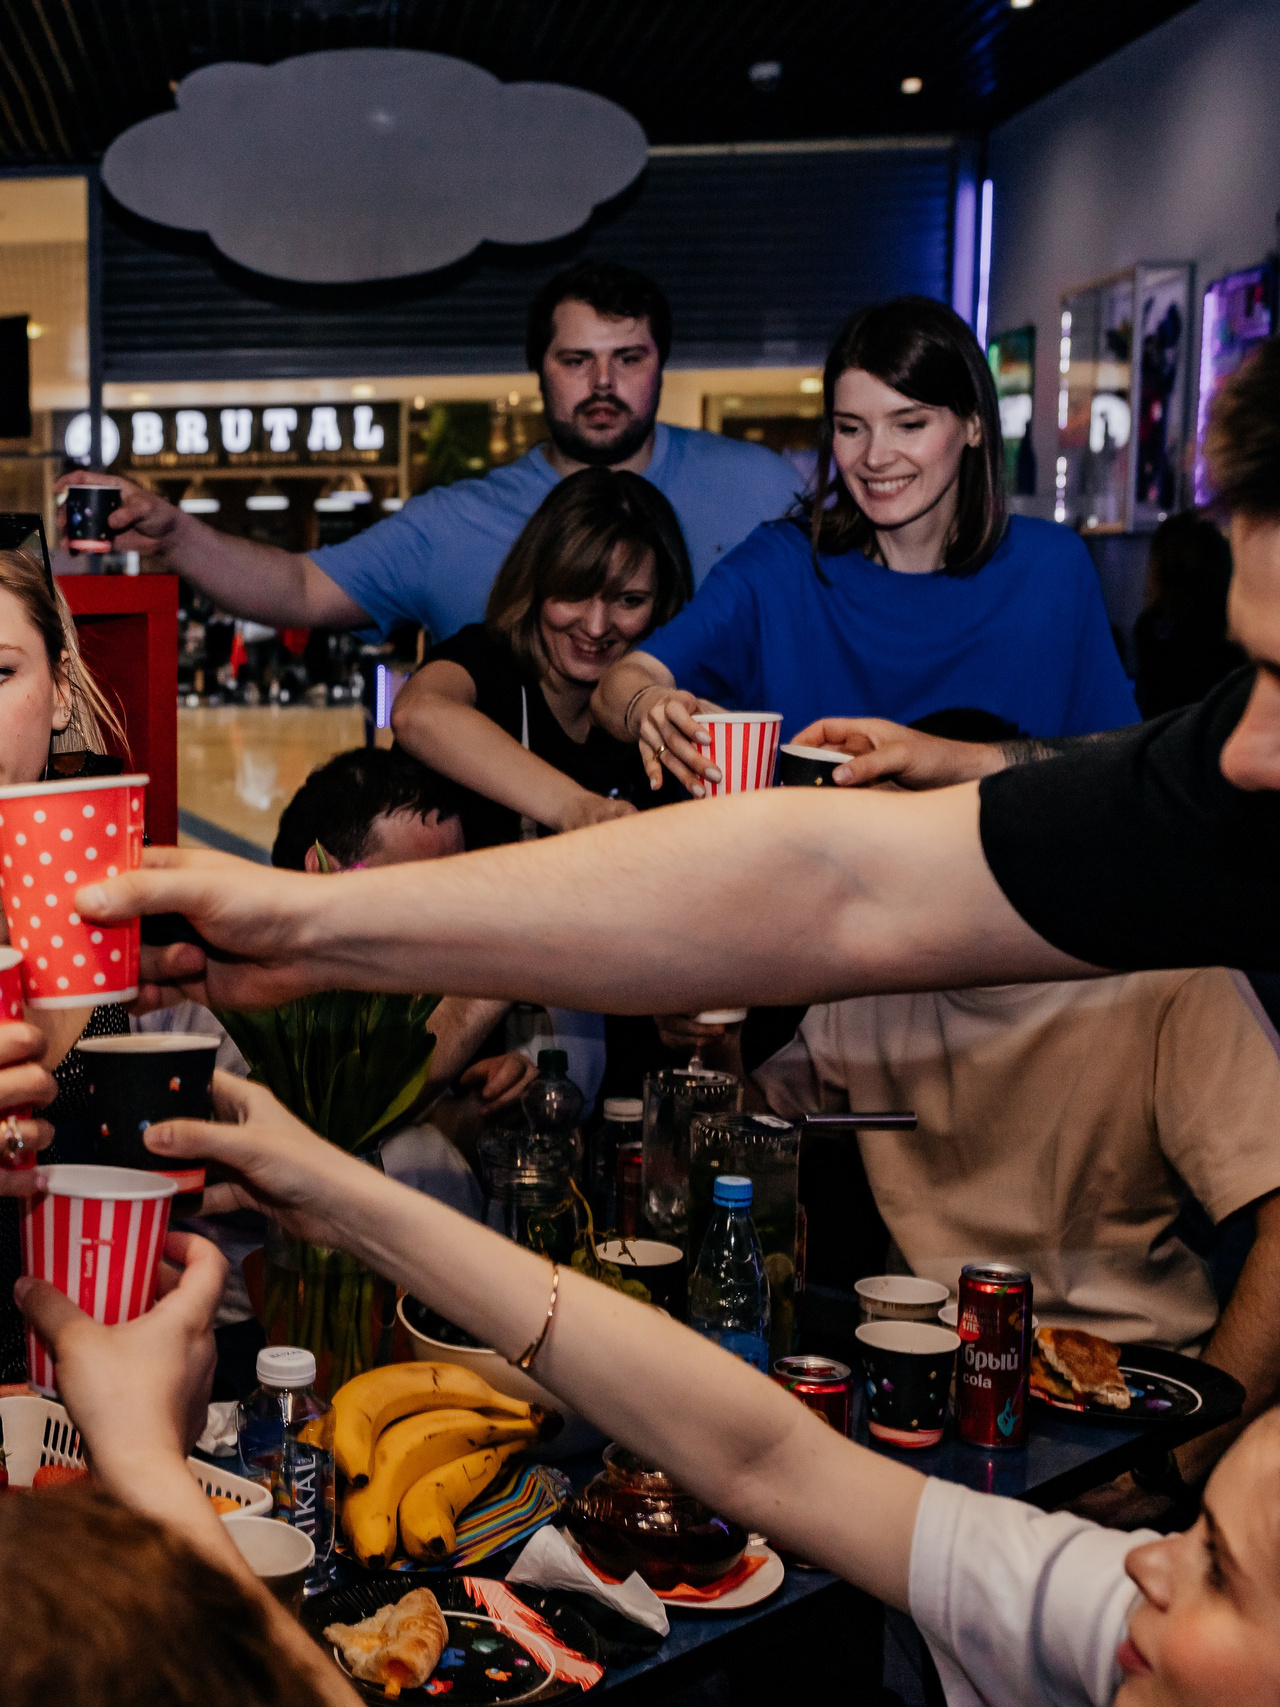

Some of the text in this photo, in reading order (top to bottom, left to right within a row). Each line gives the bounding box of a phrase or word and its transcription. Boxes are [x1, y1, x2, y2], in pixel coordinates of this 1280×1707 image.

[131, 405, 384, 455] BRUTAL
[963, 1343, 1019, 1371] брый
[962, 1373, 992, 1389] cola
[294, 1454, 316, 1567] IKAL
